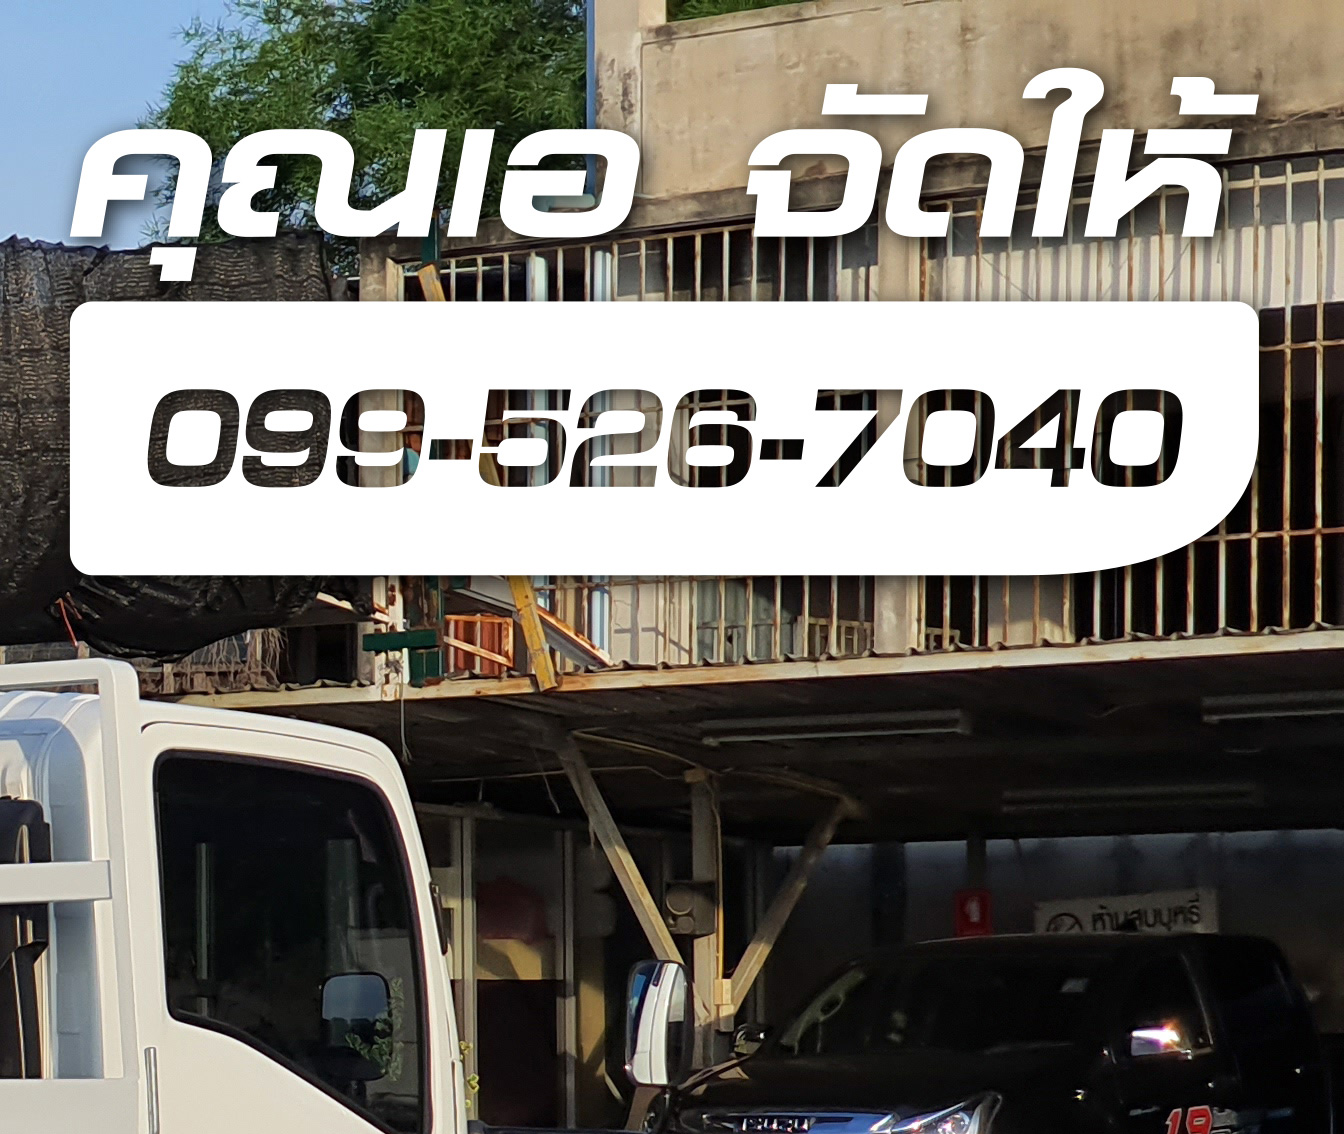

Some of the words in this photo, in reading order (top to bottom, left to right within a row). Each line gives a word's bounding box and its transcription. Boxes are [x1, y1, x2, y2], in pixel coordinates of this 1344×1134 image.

[1092, 893, 1201, 931] ห้ามสบบุหรี่
